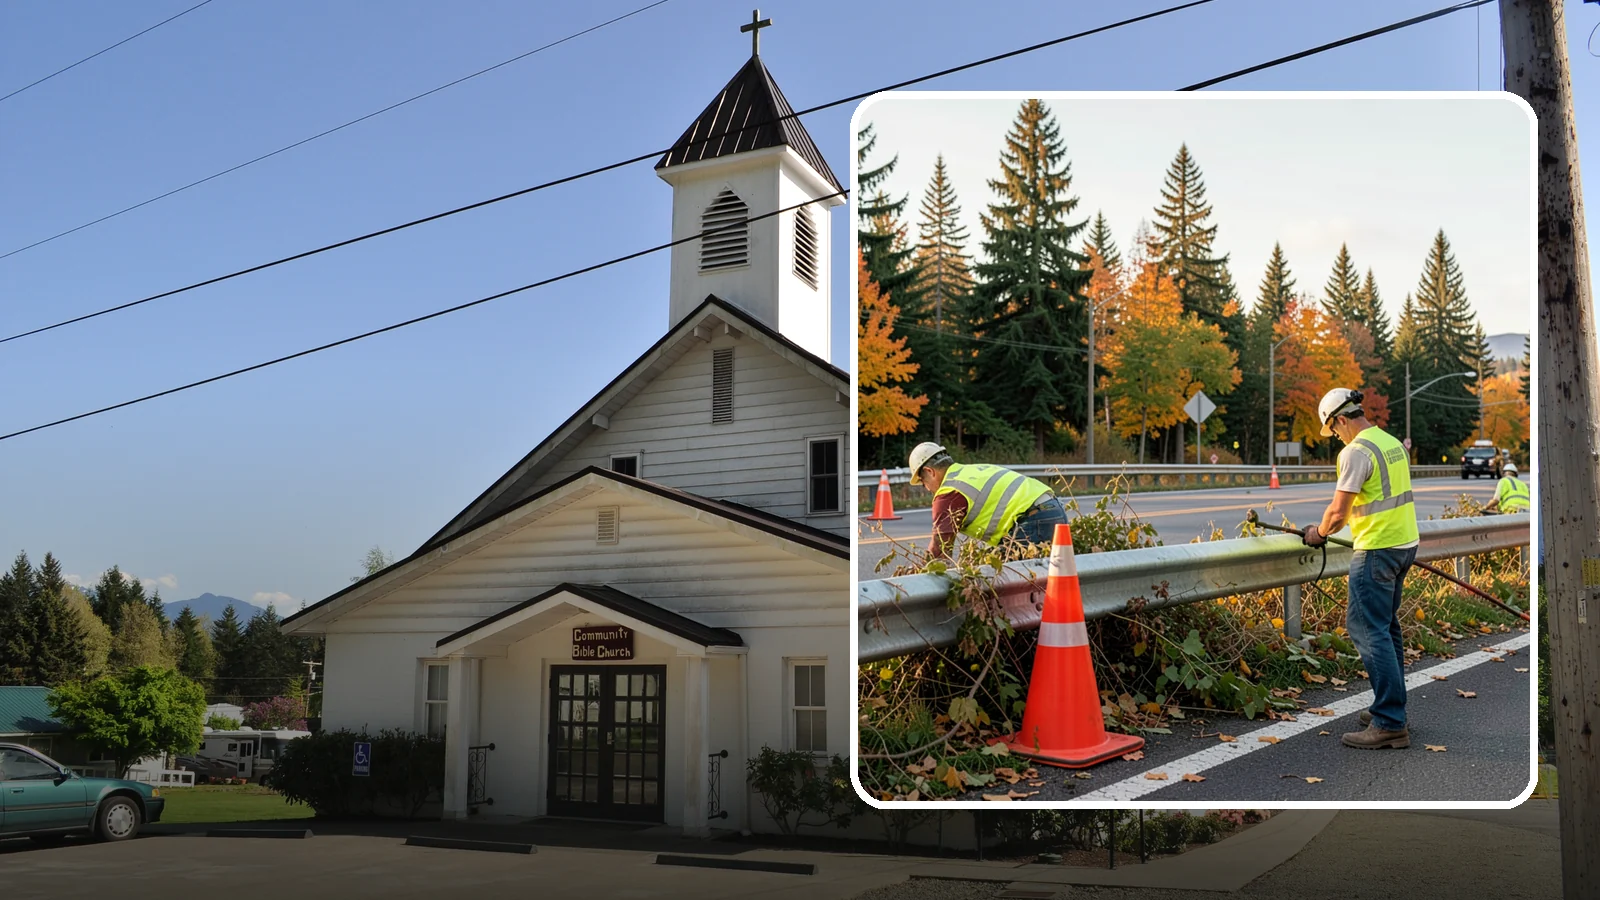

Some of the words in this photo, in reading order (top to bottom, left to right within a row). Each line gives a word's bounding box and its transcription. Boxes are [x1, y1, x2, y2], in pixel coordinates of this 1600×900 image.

[574, 627, 628, 641] Community
[572, 644, 595, 657] Bible
[597, 645, 631, 658] Church
